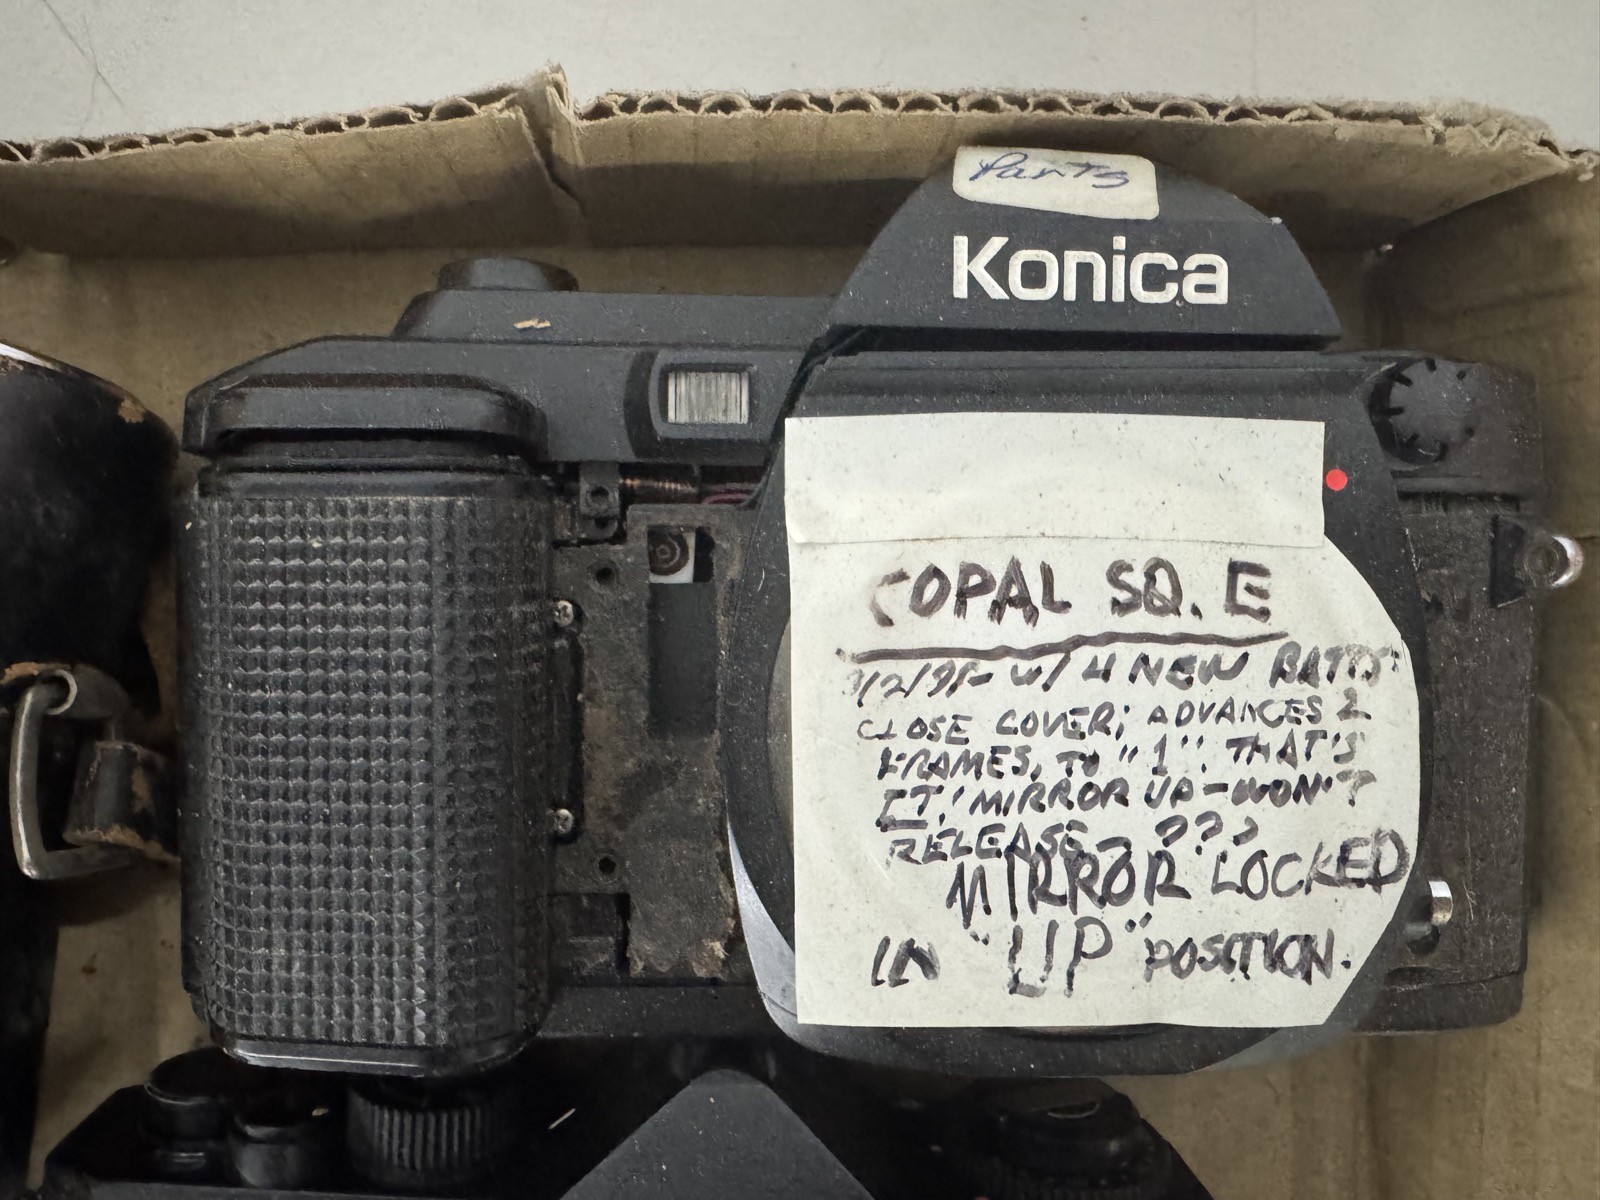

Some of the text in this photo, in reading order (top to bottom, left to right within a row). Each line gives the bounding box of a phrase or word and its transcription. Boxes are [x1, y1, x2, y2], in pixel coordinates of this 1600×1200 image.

[953, 235, 1229, 304] Konica
[868, 555, 1272, 628] COPAL SQ. E
[1128, 651, 1250, 691] NEW
[856, 714, 974, 746] CLOSE
[1146, 695, 1323, 729] ADVANCES
[1055, 748, 1101, 778] TO
[945, 828, 1410, 930] MIRROR LOCKED
[871, 935, 940, 988] IN
